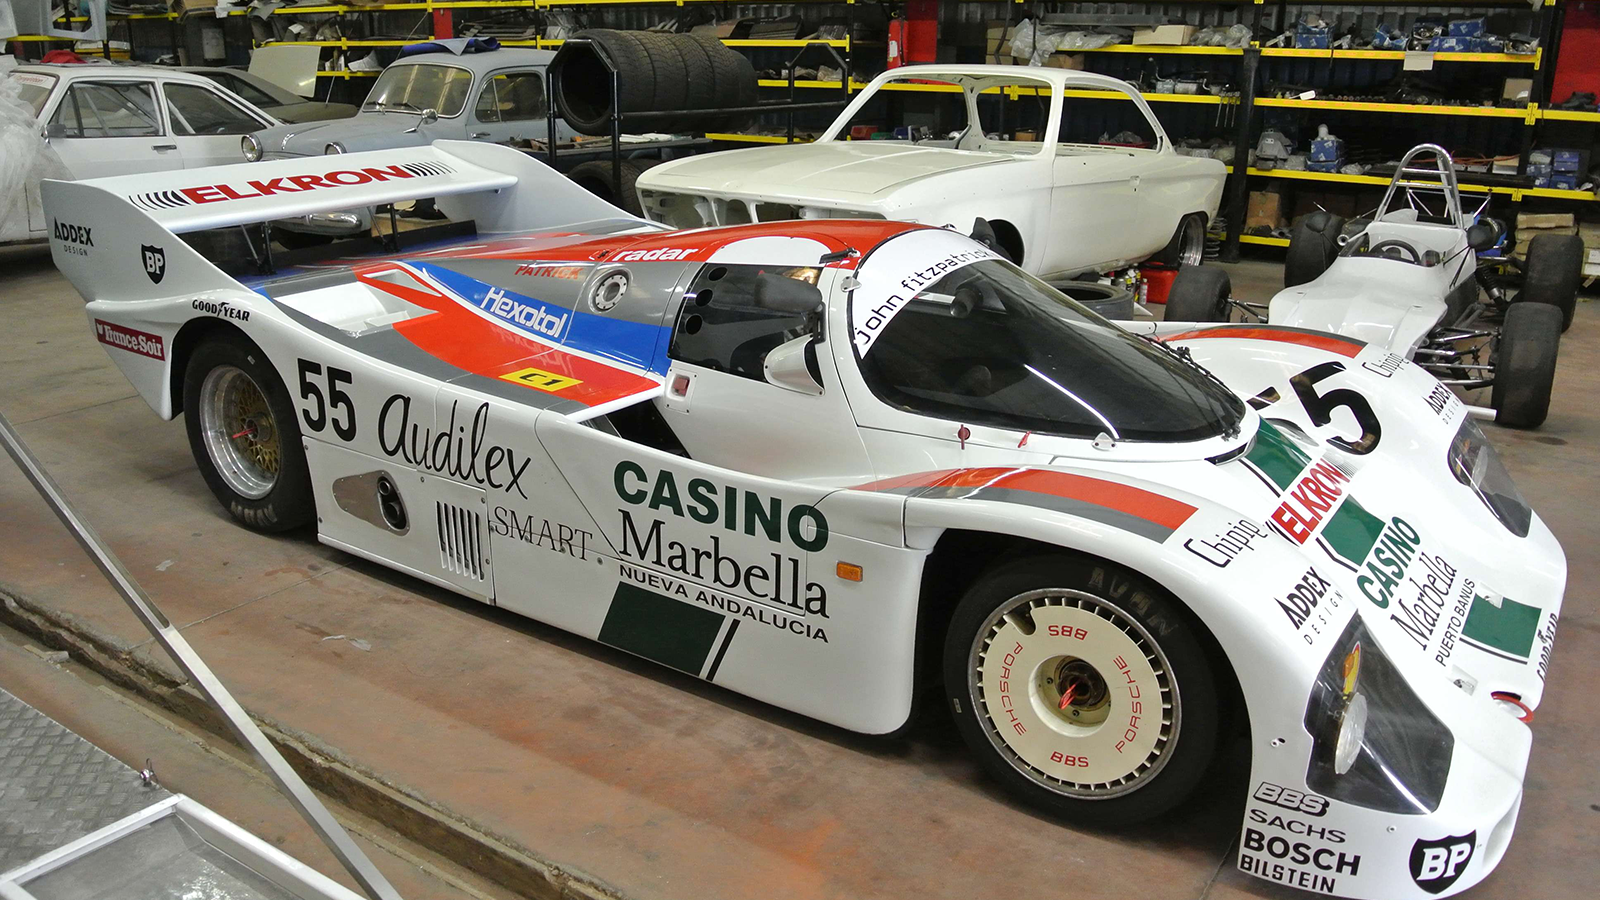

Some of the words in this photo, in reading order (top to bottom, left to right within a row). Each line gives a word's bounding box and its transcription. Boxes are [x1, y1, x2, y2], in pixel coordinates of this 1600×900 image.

[179, 164, 415, 205] ELKRON
[53, 216, 95, 248] ADDEX
[63, 244, 89, 257] DESIGN
[611, 247, 699, 262] radar
[144, 252, 165, 277] BP
[514, 264, 584, 280] PATRICK
[191, 298, 250, 322] GOODYEAR
[480, 287, 569, 338] Hexotol
[854, 294, 904, 345] john
[901, 248, 992, 292] fitzpatrick
[297, 358, 357, 442] 55
[519, 373, 563, 386] C1
[1421, 382, 1453, 416] ADDEX
[613, 460, 829, 552] CASINO
[1270, 457, 1351, 545] ELKRON
[493, 506, 593, 562] SMART
[617, 508, 829, 618] Marbella
[1356, 516, 1421, 609] CASINO
[619, 564, 688, 598] NUEVA
[695, 589, 829, 643] ANDALUCIA
[1273, 566, 1331, 630] ADDEX
[1303, 590, 1344, 645] DESIGN
[1390, 551, 1457, 651] Marbella
[1435, 615, 1462, 667] PUERTO
[1457, 578, 1476, 618] BANUS
[1047, 624, 1088, 641] BBS
[1000, 642, 1027, 736] PORSCHE
[1112, 655, 1142, 753] PORSCHE
[1050, 751, 1089, 768] BBS
[1253, 781, 1330, 817] BBS
[1249, 808, 1347, 843] SACHS
[1240, 854, 1336, 893] BILSTEIN
[1243, 827, 1361, 876] BOSCH
[1416, 842, 1471, 881] BP
